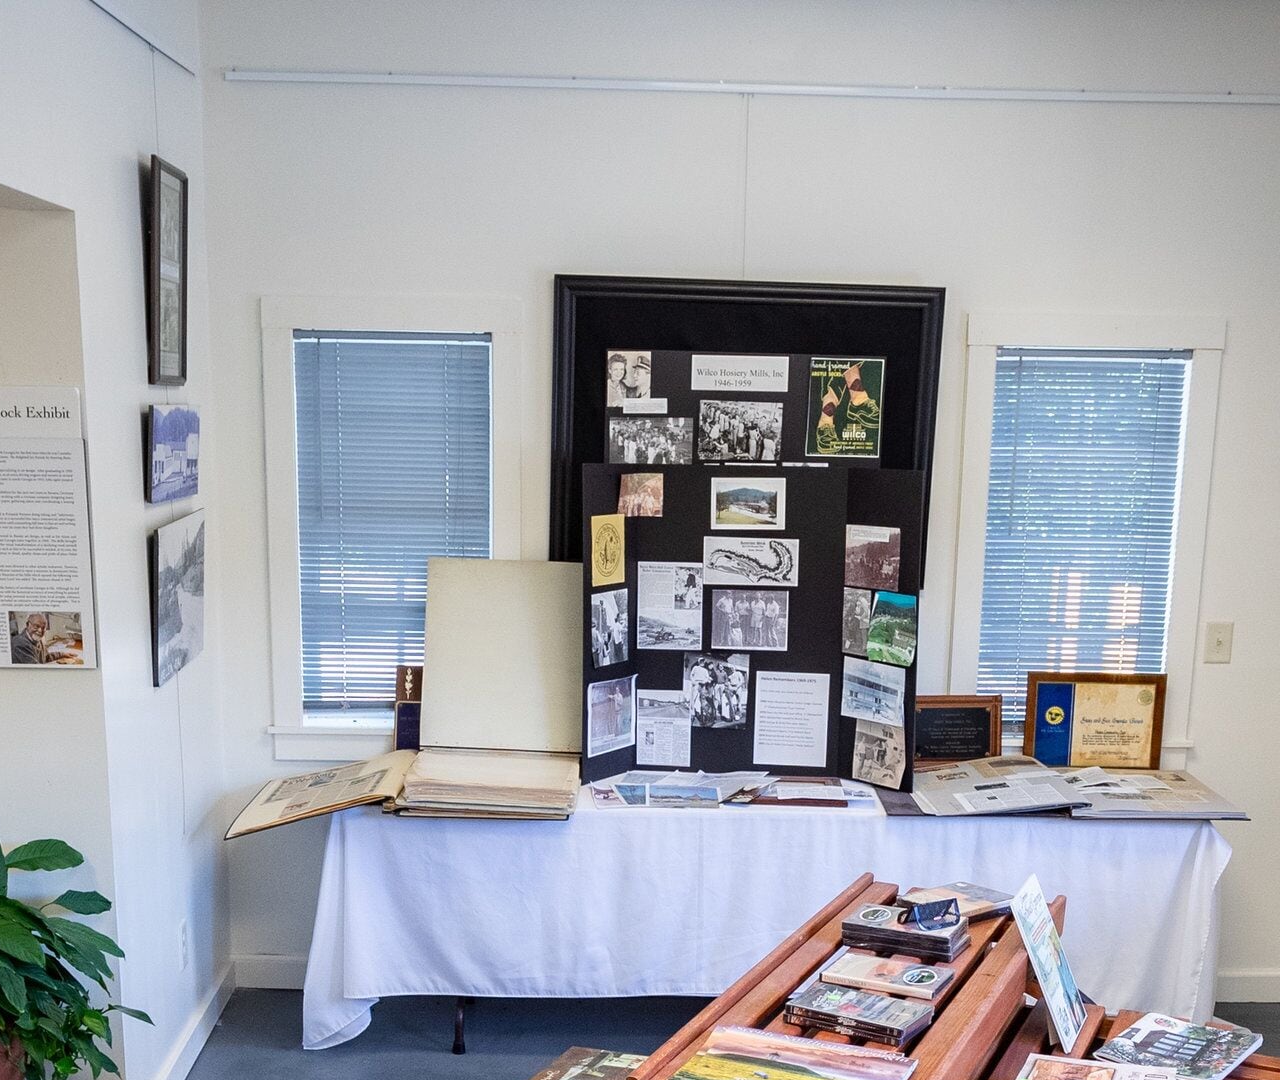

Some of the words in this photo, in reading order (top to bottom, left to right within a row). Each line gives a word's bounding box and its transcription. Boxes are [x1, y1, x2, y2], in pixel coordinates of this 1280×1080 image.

[696, 368, 718, 376] Wilco
[720, 369, 747, 378] Hosiery
[750, 370, 771, 378] Mills,
[772, 370, 784, 378] Inc
[26, 406, 70, 419] Exhibit
[842, 424, 866, 439] wilco
